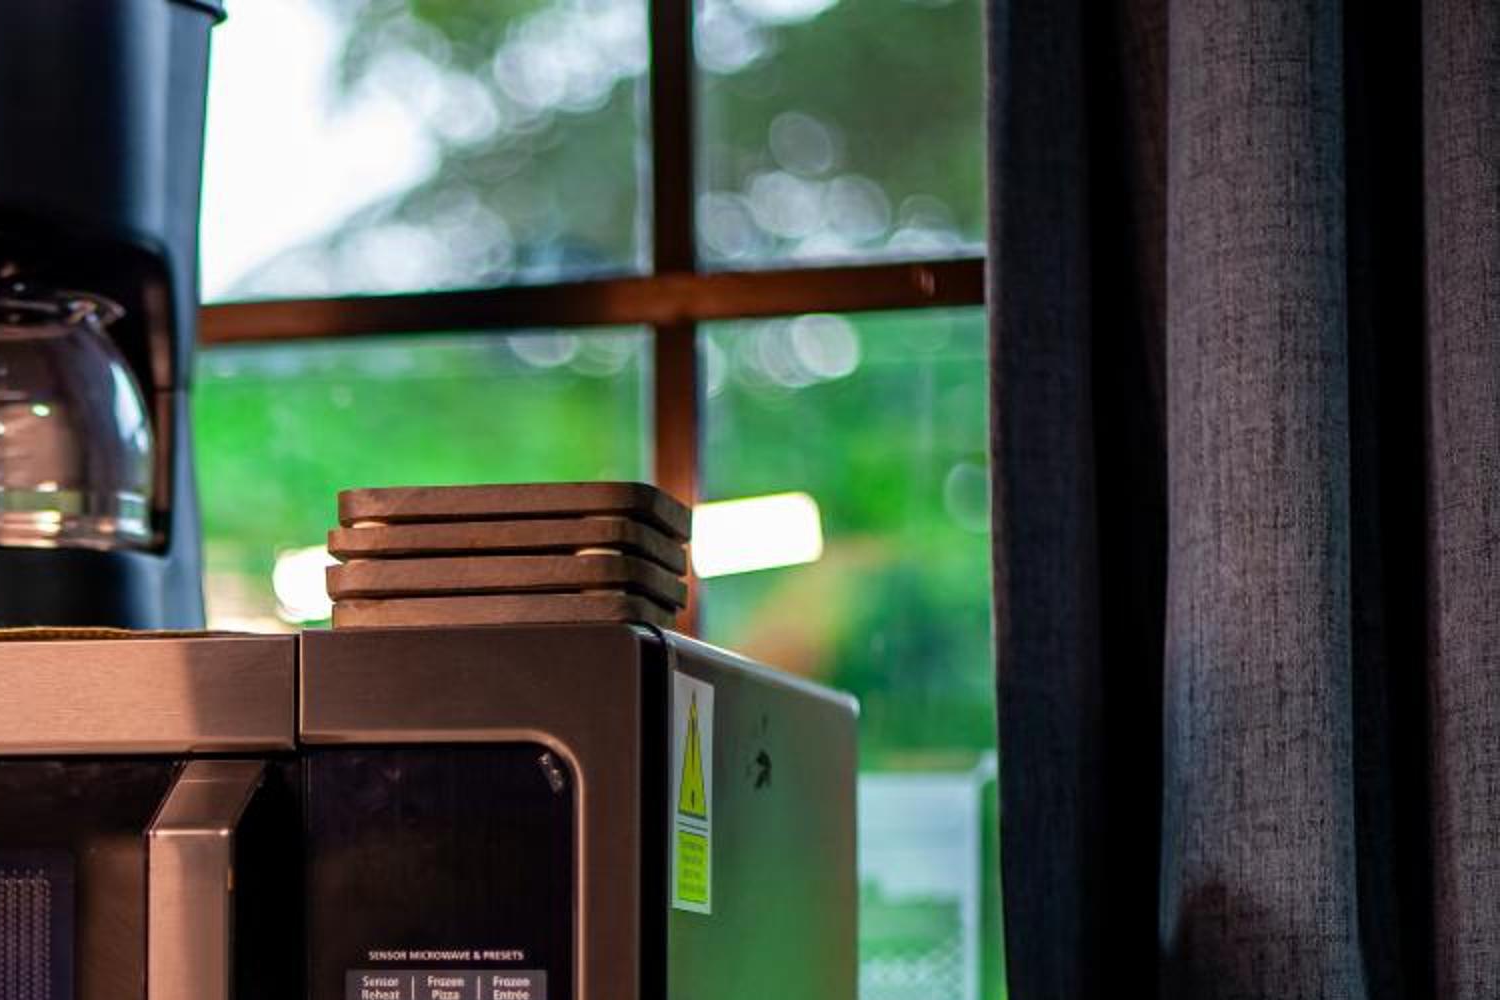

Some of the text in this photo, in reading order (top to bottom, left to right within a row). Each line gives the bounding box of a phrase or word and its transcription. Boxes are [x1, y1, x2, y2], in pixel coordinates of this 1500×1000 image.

[368, 951, 524, 961] SENSOR MICROWAVE & PRESETS
[362, 976, 399, 987] Sensor
[427, 976, 465, 987] Frozen
[493, 976, 531, 987] Frozen
[361, 989, 400, 1000] Reheat
[431, 989, 461, 1000] Pizza
[493, 990, 530, 1000] Entrée
